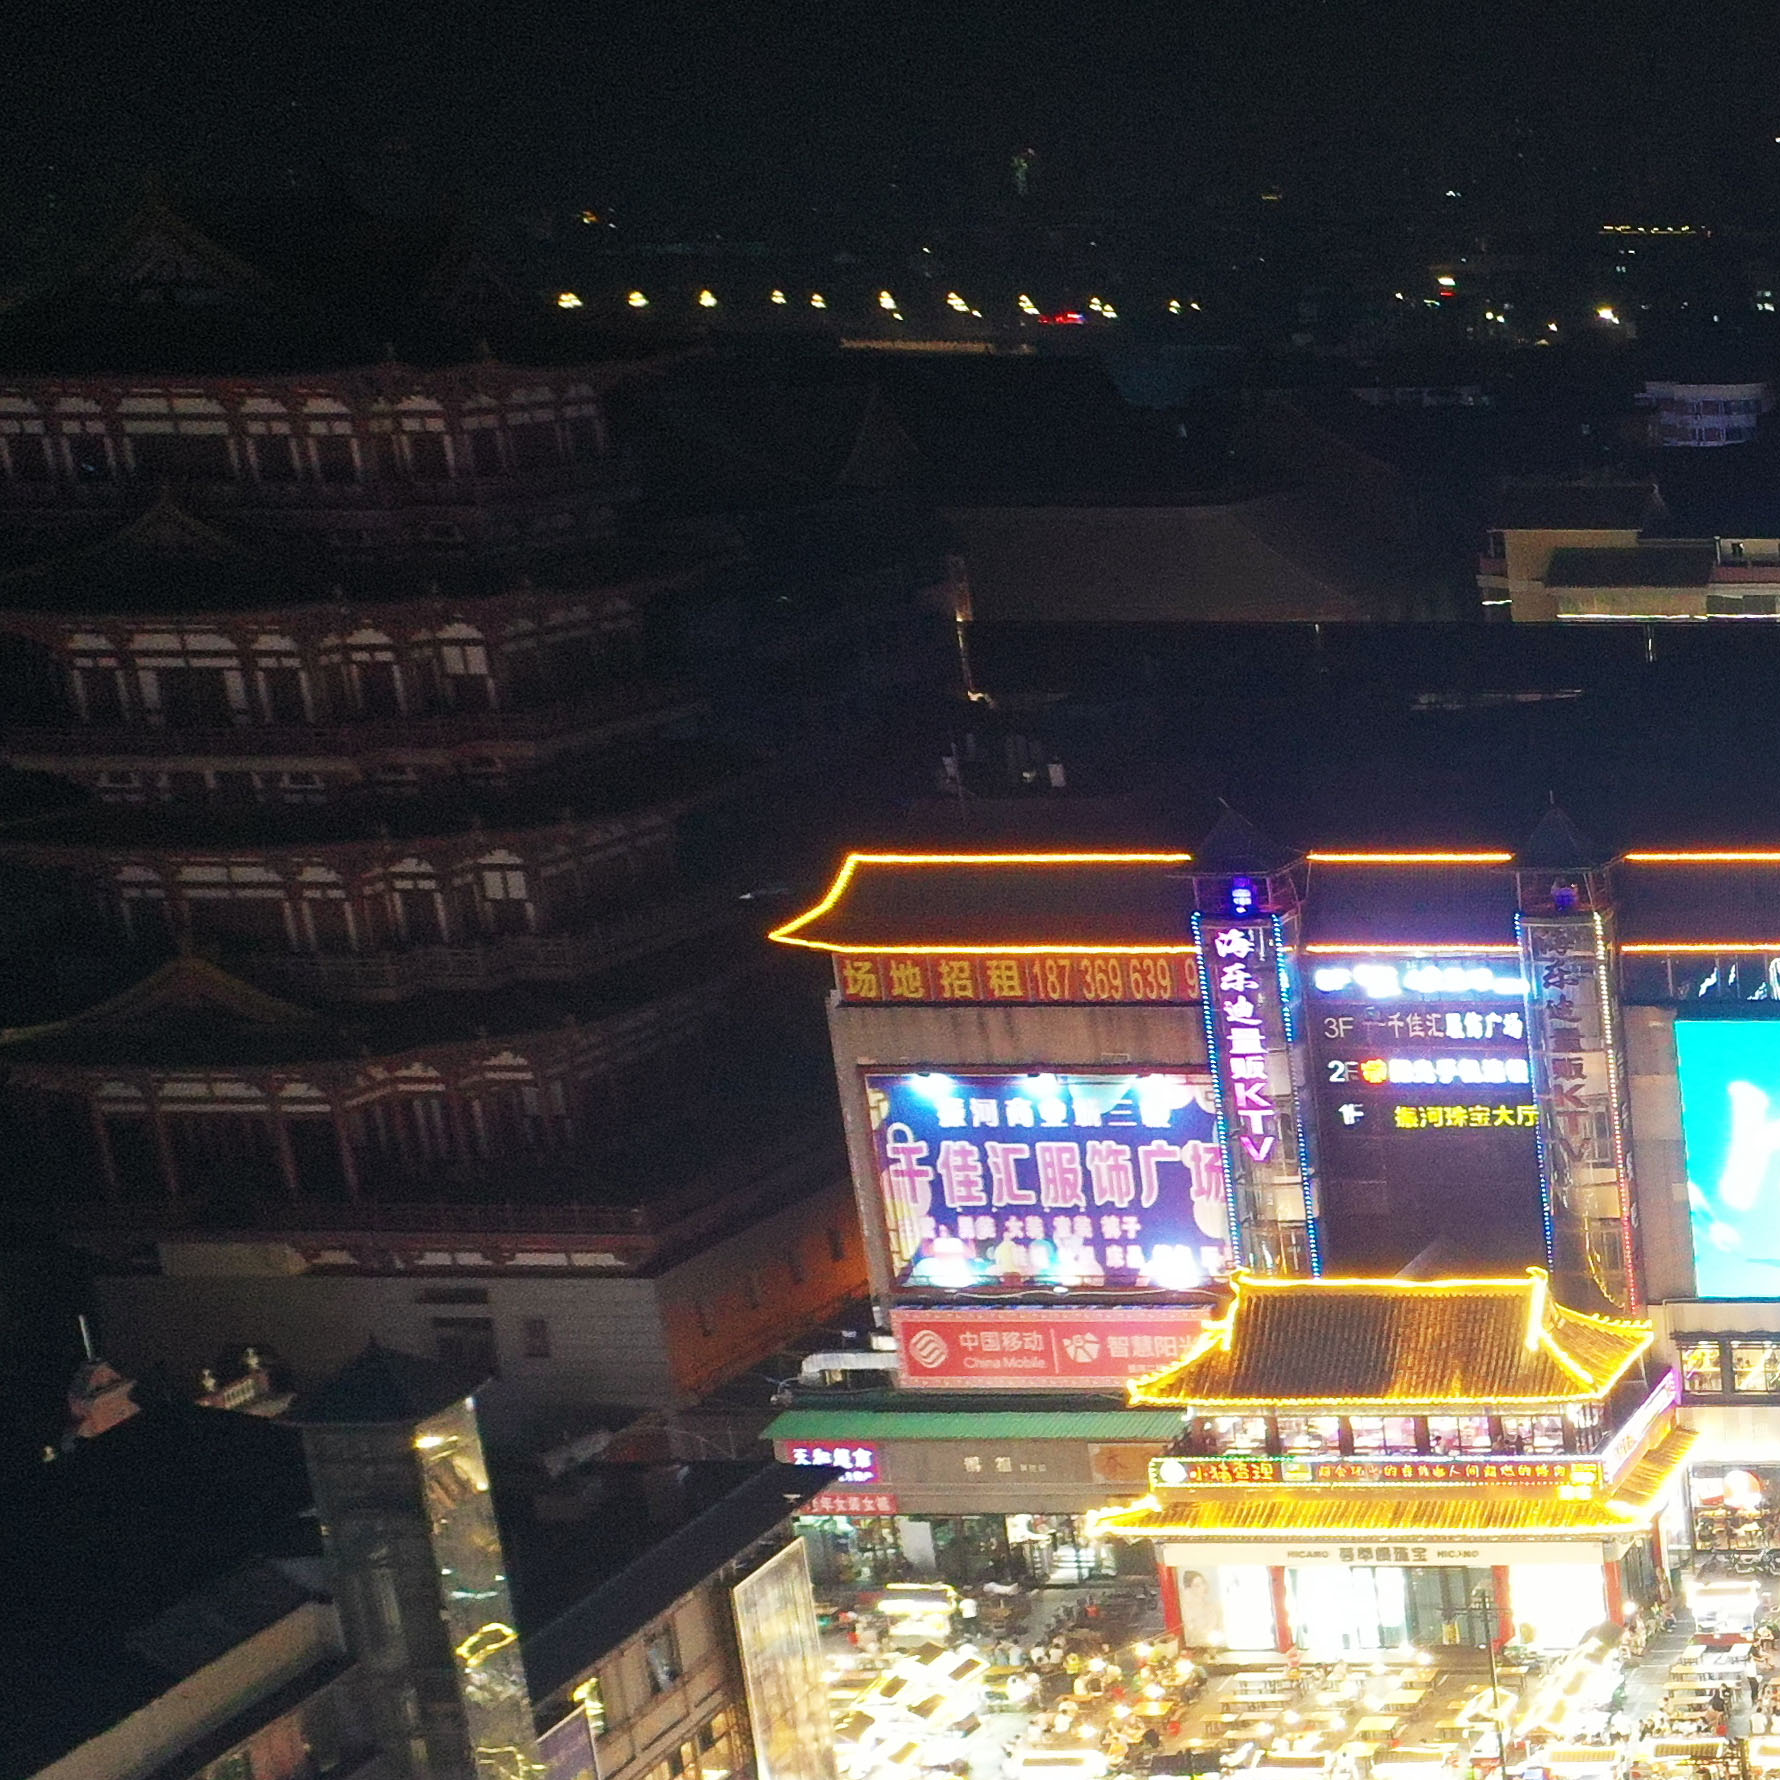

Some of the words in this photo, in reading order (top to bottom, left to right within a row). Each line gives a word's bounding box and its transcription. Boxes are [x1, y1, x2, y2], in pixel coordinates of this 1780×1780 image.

[843, 958, 1024, 999] 场地招租
[1033, 958, 1071, 999] 187
[1082, 958, 1122, 999] 369
[1130, 958, 1172, 999] 639
[1324, 1017, 1354, 1039] 3F
[886, 1139, 1228, 1209] 千佳汇服饰广场
[959, 1331, 1045, 1352] 中国移动
